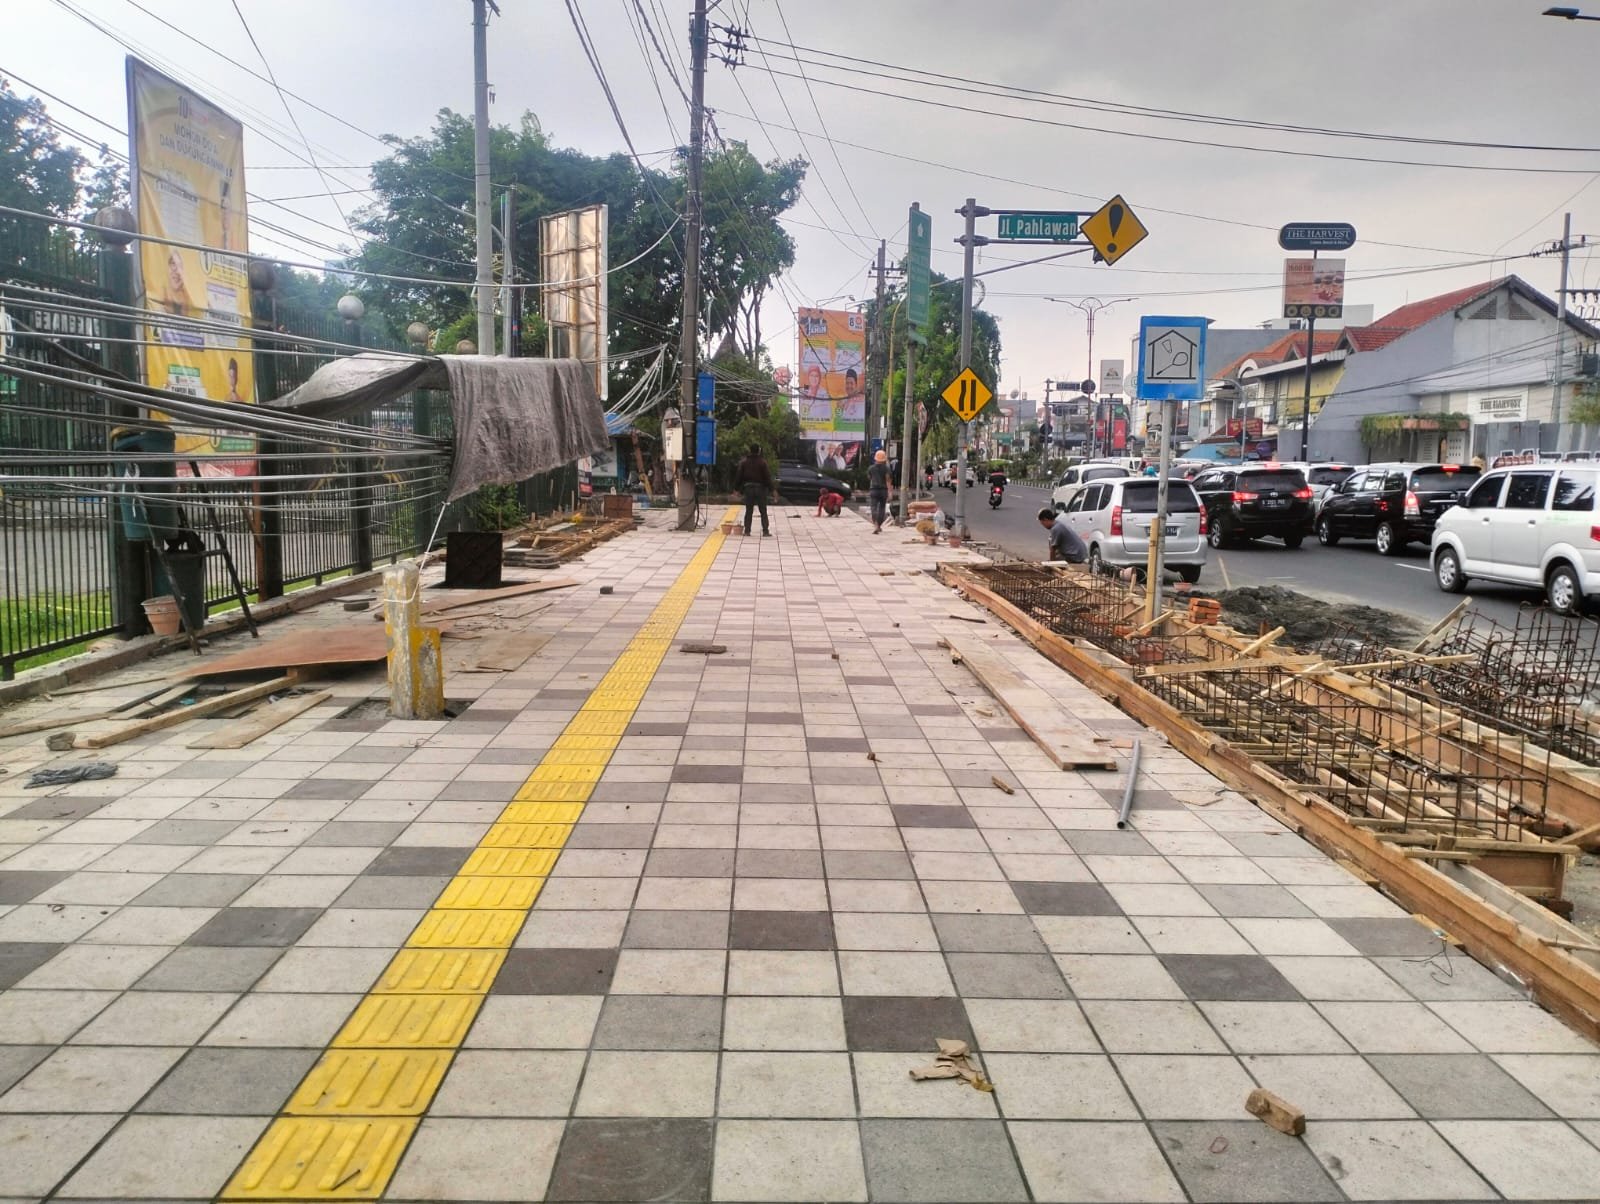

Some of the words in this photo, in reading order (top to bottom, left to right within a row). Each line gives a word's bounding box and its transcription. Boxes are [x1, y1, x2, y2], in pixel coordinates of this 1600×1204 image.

[1017, 219, 1077, 236] Pahlawan
[1287, 229, 1305, 238] THE
[1307, 229, 1351, 241] HARVEST
